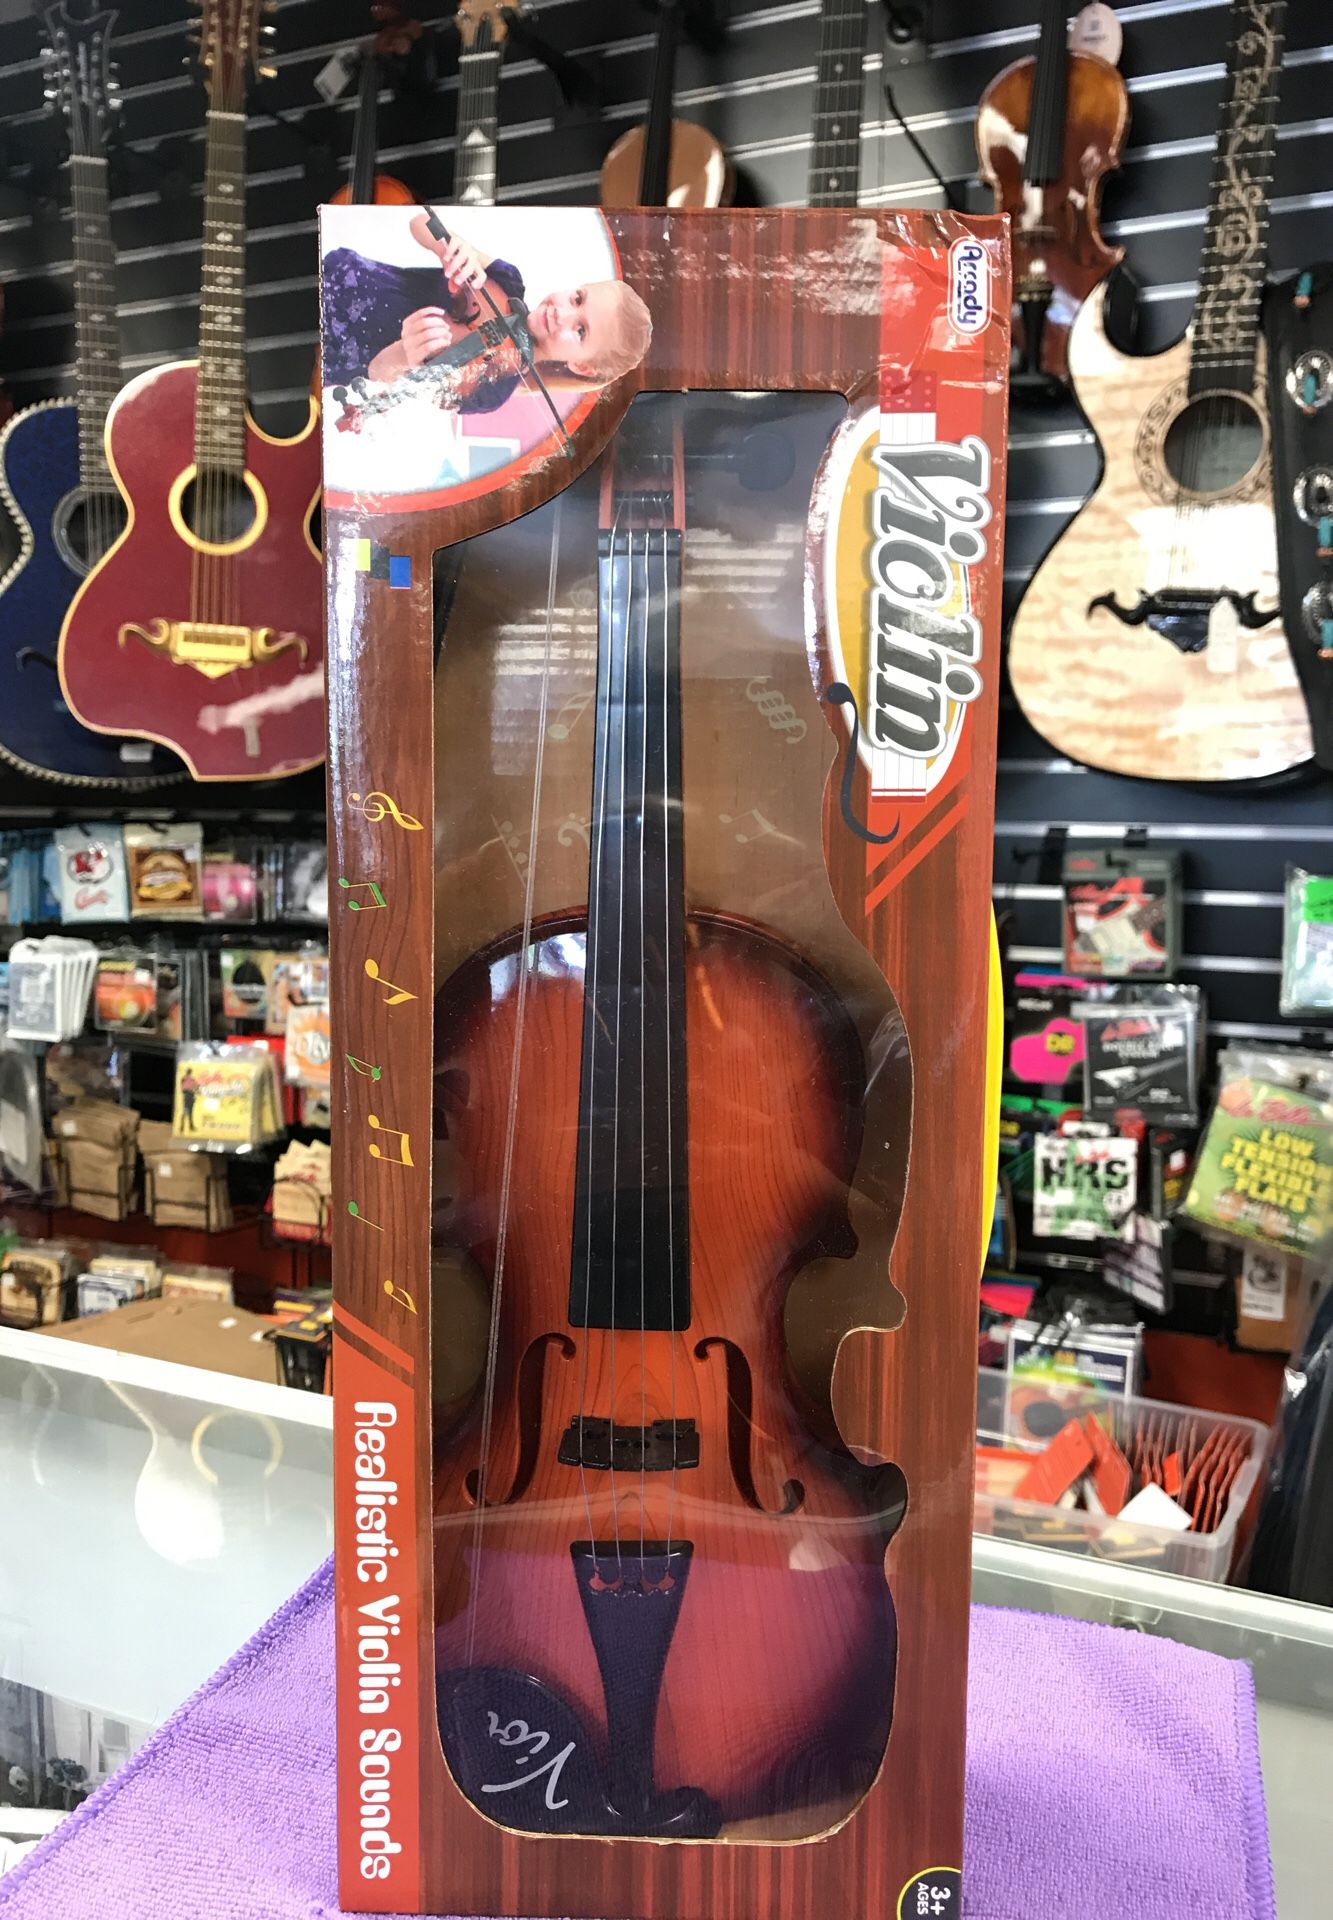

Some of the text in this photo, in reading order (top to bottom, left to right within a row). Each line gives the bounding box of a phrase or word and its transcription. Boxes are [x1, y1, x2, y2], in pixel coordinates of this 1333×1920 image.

[957, 246, 983, 324] Arcady
[872, 437, 989, 757] Violin
[1260, 1127, 1315, 1158] LOW
[1235, 1176, 1307, 1213] FLATS
[354, 1401, 402, 1880] Realistic Violin Sounds
[917, 1881, 929, 1916] AGES
[930, 1886, 951, 1916] 3+
